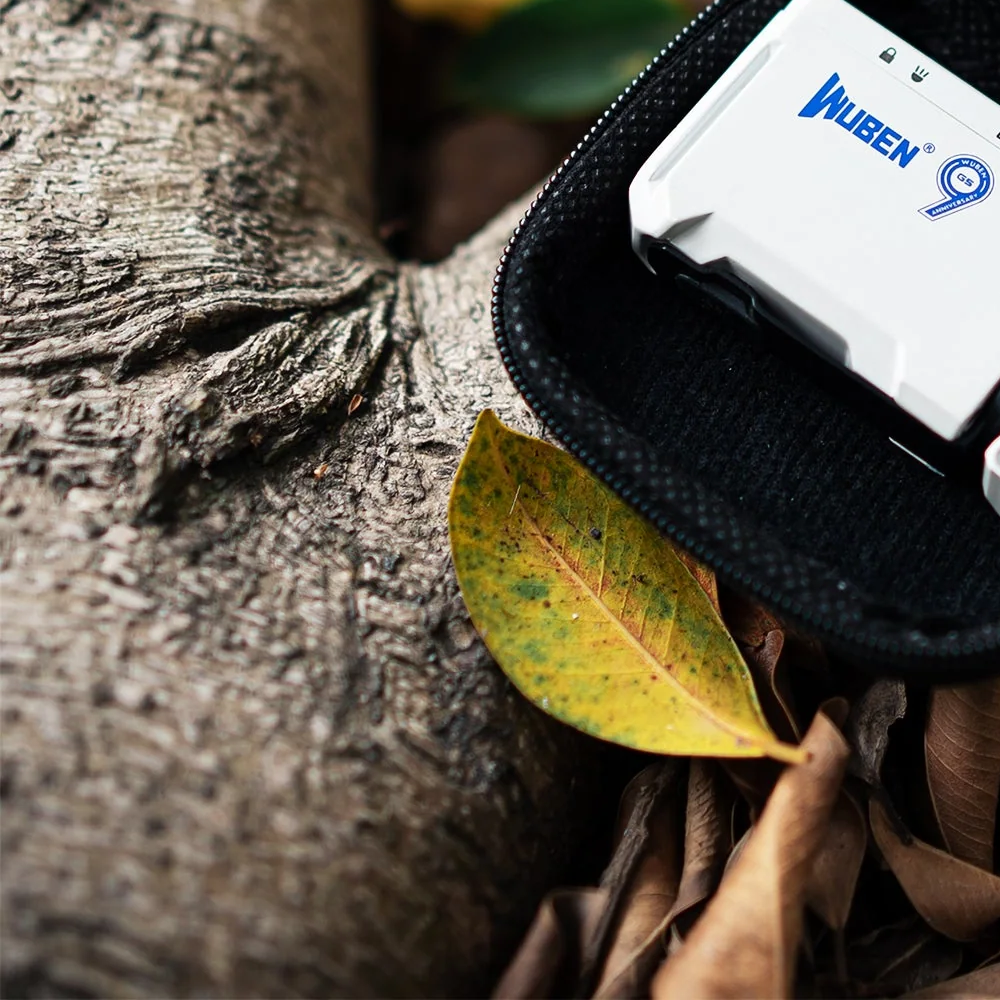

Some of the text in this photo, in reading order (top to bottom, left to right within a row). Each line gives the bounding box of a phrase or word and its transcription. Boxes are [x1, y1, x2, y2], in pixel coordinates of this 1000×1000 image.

[798, 72, 920, 168] WUBEN
[961, 159, 987, 179] WUBEN
[931, 193, 978, 215] ANNIVERSARY
